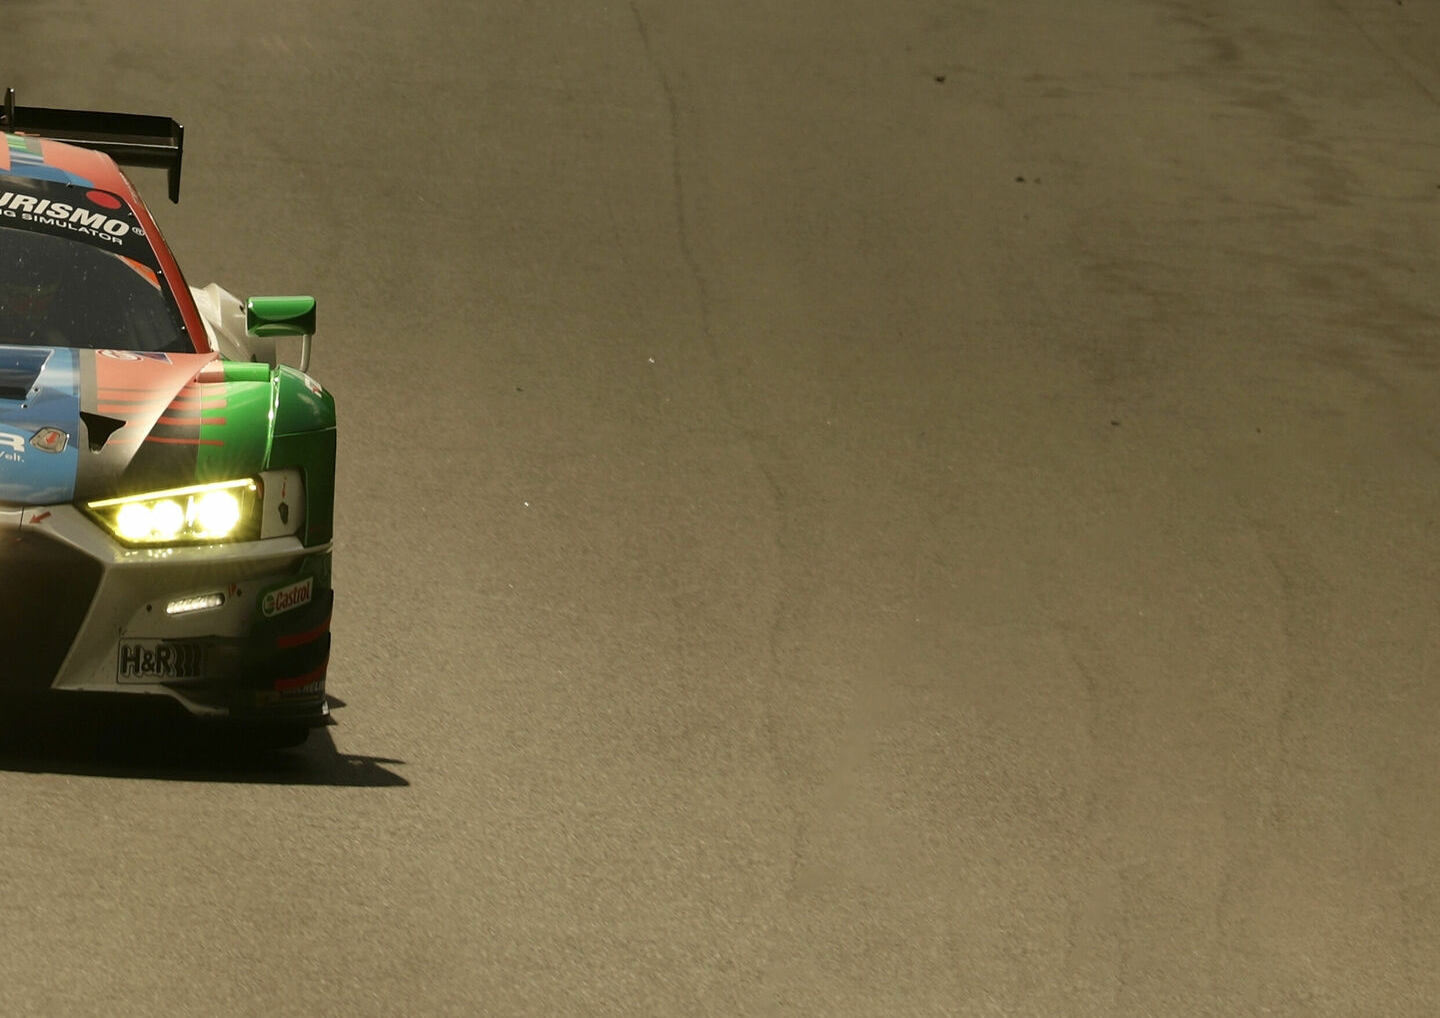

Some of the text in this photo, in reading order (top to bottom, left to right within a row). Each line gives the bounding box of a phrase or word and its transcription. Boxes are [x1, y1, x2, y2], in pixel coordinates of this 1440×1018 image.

[21, 212, 124, 247] SIMULATOR
[275, 582, 311, 612] Castrol
[120, 644, 171, 675] H&R
